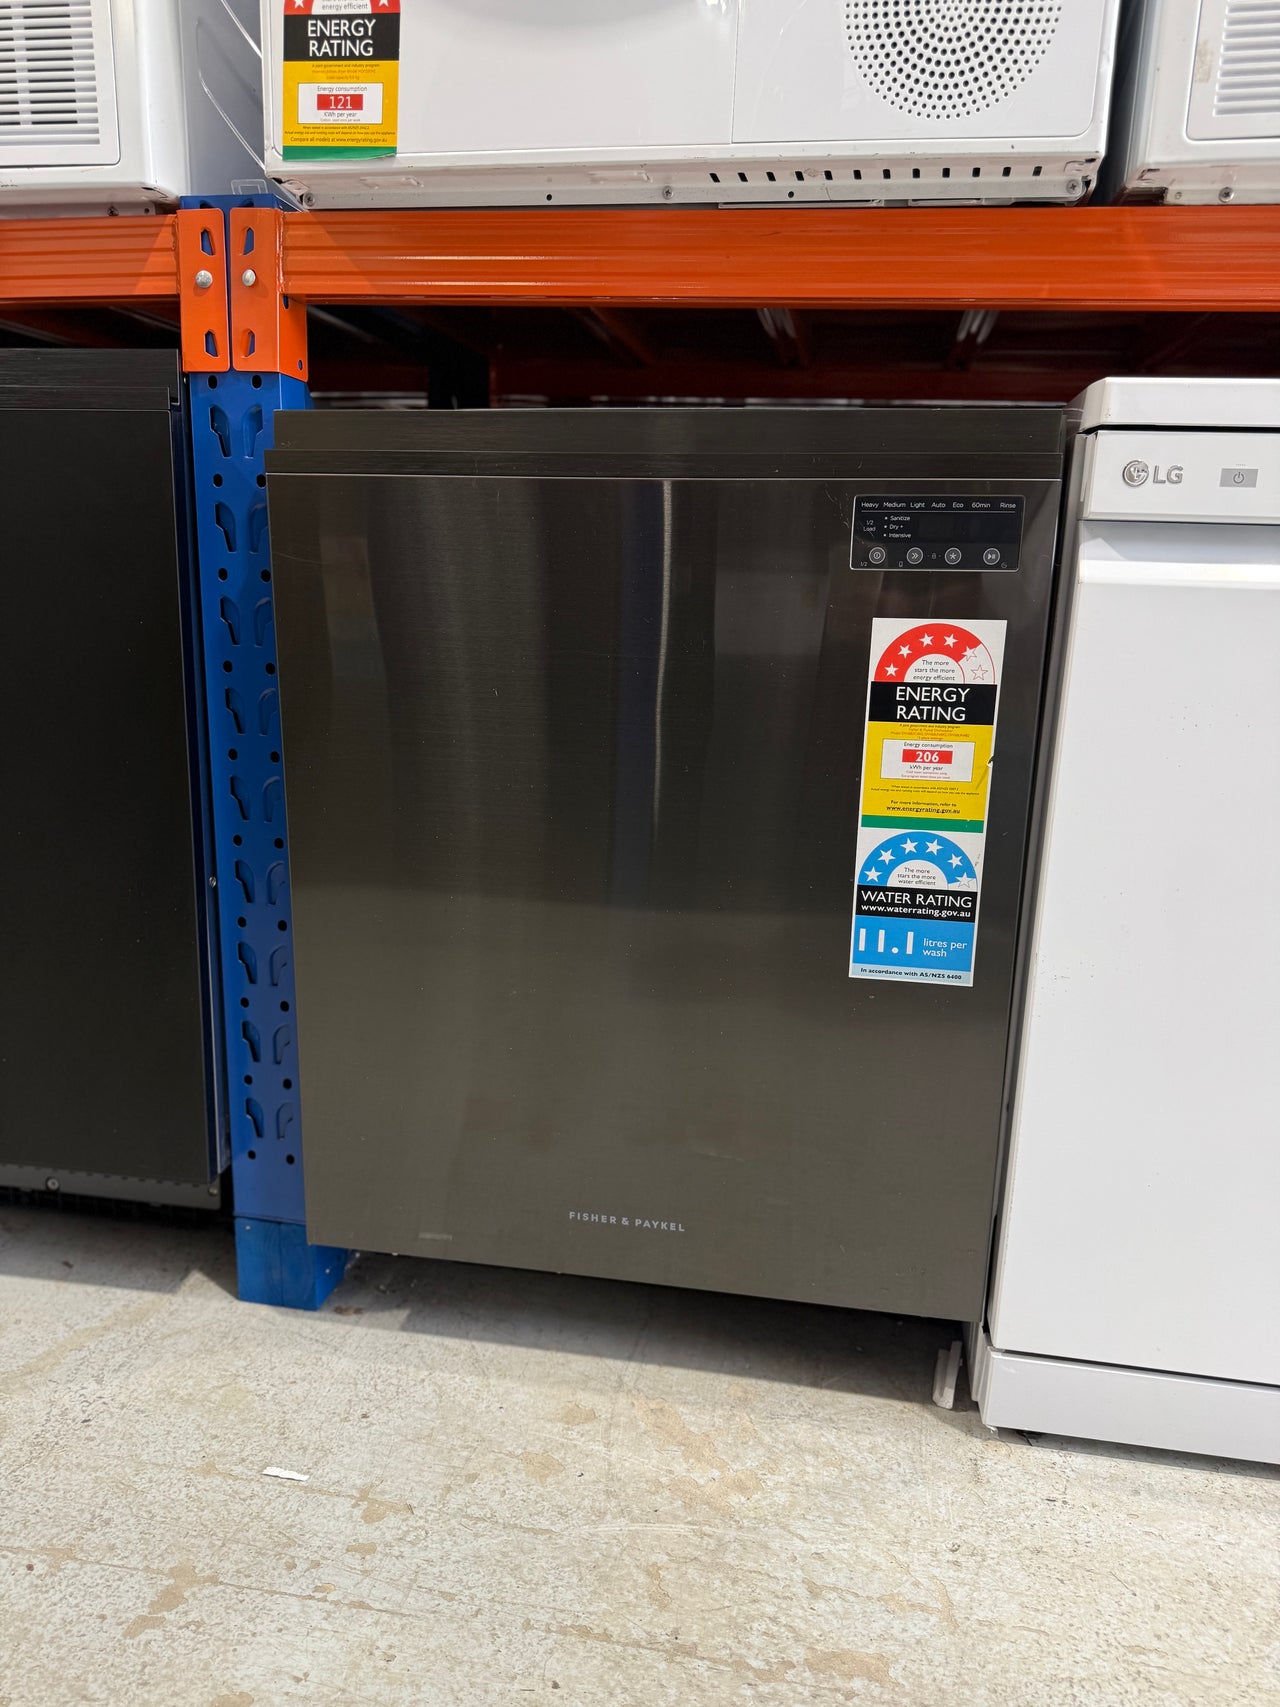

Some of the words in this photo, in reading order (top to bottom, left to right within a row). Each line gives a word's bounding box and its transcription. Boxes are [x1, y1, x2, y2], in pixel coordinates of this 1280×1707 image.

[307, 18, 376, 37] ENERGY
[309, 39, 374, 57] RATING
[329, 96, 352, 109] 121
[1152, 465, 1184, 484] LG
[896, 686, 970, 702] ENERGY
[896, 706, 966, 721] RATING
[916, 752, 939, 762] 206
[861, 890, 912, 904] WATER
[916, 893, 972, 908] RATING
[861, 905, 971, 917] www.waterrating.gov.au
[859, 928, 914, 954] 11.1
[923, 938, 947, 948] litres
[950, 942, 967, 950] per
[922, 949, 947, 957] wash
[569, 1211, 617, 1224] FISHER
[621, 1217, 629, 1225] &
[635, 1219, 685, 1232] PAYKEL
